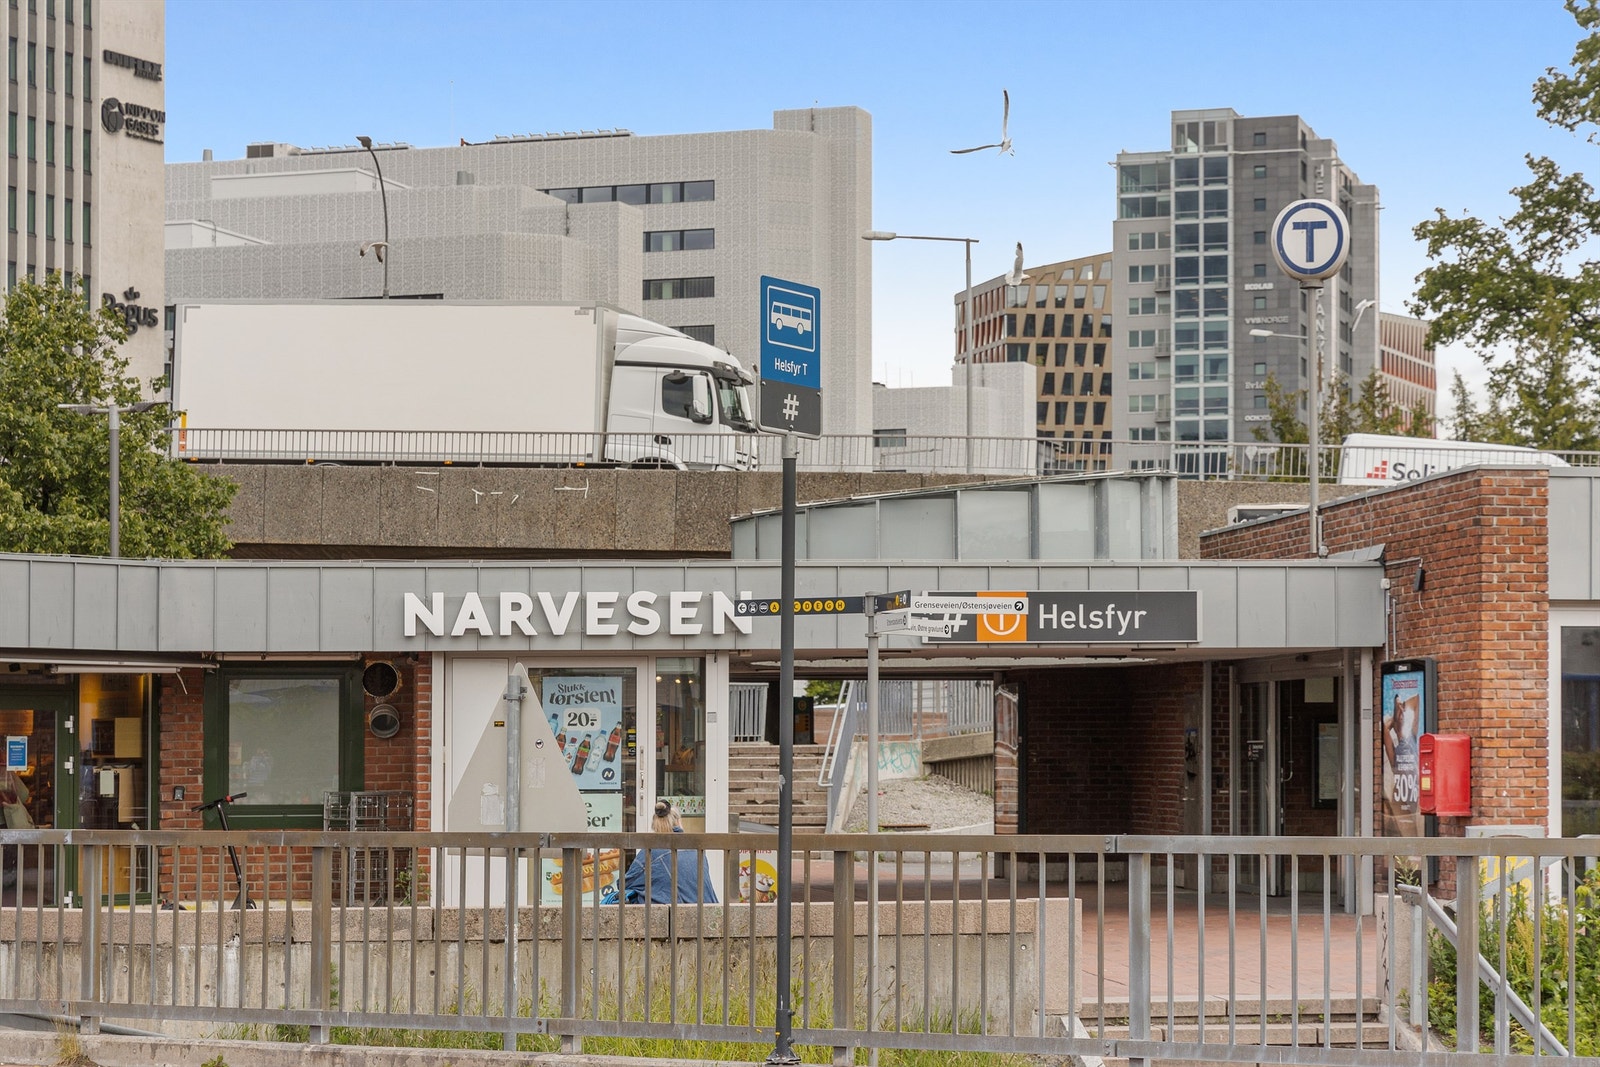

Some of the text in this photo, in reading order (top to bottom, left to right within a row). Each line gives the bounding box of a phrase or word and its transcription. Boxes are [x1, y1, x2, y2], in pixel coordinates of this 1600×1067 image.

[125, 102, 166, 124] NIPPON
[125, 117, 160, 136] GASES
[1293, 220, 1328, 263] T
[774, 357, 808, 377] Helsfyr T
[403, 590, 752, 637] NARVESEN
[1038, 603, 1148, 636] Helsfyr
[549, 688, 617, 706] tørsten!
[557, 683, 586, 694] Slukk
[1394, 773, 1418, 803] 30%
